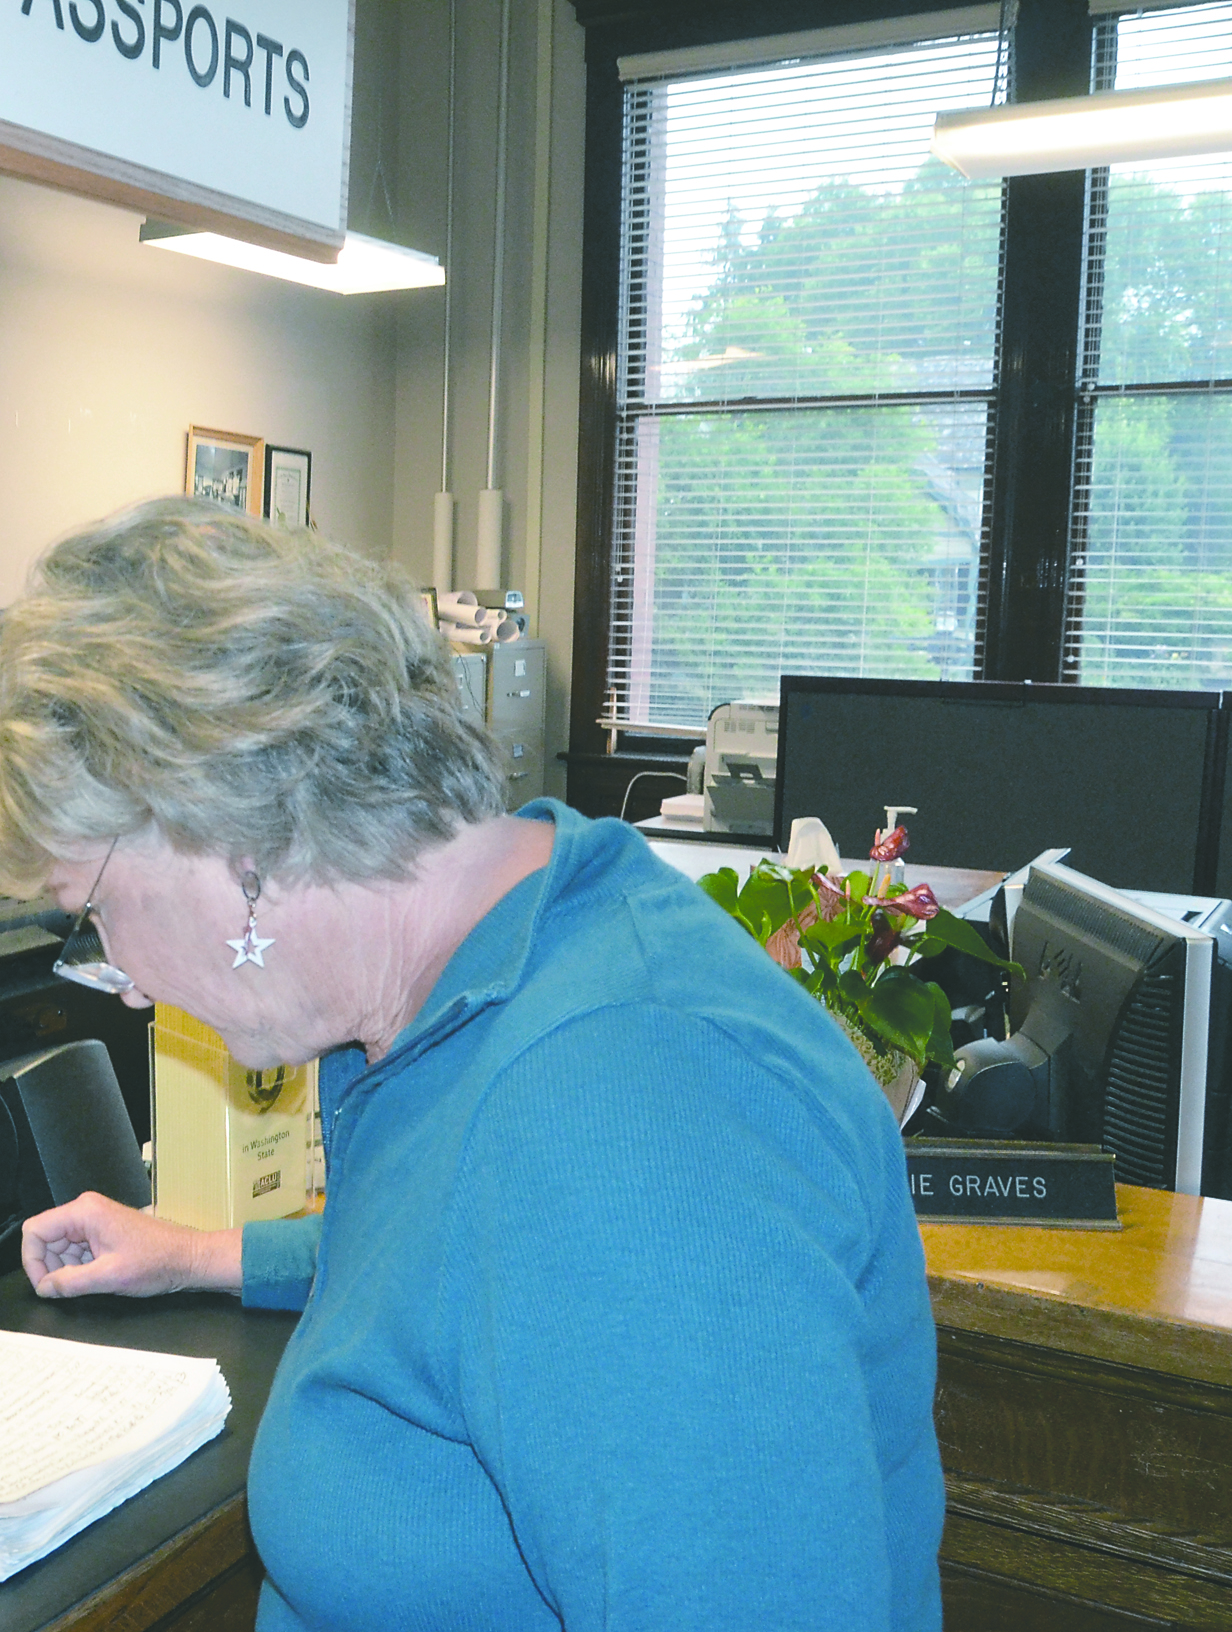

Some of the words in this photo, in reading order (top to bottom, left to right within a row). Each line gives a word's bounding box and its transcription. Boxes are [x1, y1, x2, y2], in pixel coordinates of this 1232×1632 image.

[242, 1143, 250, 1154] in
[250, 1130, 290, 1150] Washington
[257, 1148, 275, 1161] State
[911, 1173, 935, 1196] IE
[949, 1174, 1048, 1199] GRAVES
